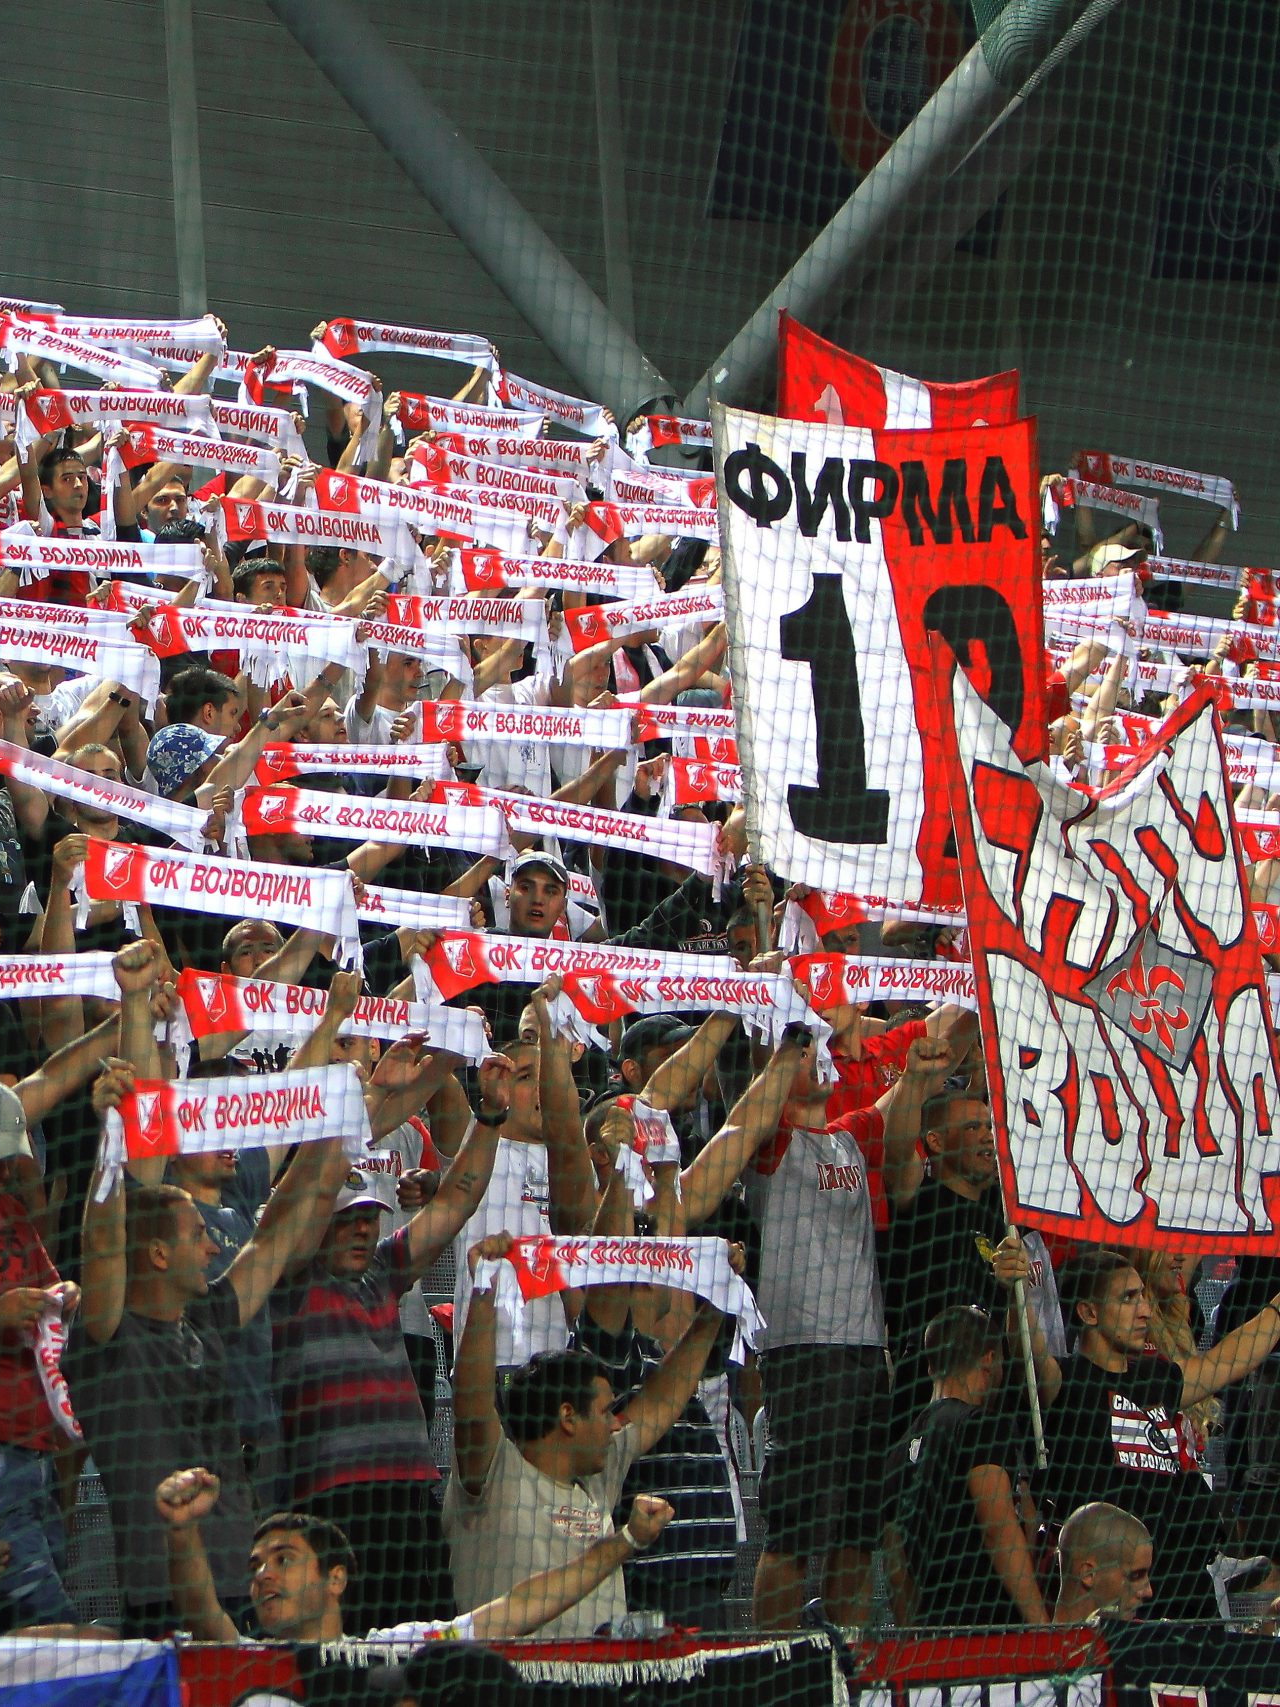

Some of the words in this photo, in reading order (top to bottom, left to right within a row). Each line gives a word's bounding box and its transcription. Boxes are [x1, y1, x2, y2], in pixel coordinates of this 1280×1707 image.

[12, 327, 37, 343] ФК
[38, 332, 121, 369] ВОЈВОДИНА
[357, 326, 376, 342] ФК
[380, 328, 452, 350] ВОЈВОДИНА
[292, 359, 372, 400] ВОЈВОДИНА
[70, 395, 93, 413] ФК
[99, 395, 187, 417] ВОЈВОДИНА
[431, 406, 449, 423] ФК
[454, 407, 521, 432] ВОЈВОДИНА
[508, 382, 524, 400] ФК
[528, 389, 585, 425] ВОЈВОДИНА
[215, 406, 279, 437] ВОДИНА
[157, 437, 176, 454] ФК
[182, 439, 259, 466] ВОЈВОДИНА
[468, 438, 493, 457] ФК
[496, 438, 582, 464] ВОЈВОДИНА
[449, 458, 471, 481] ФК
[476, 465, 558, 496] ВОЈВОДИНА
[1112, 462, 1131, 477] ФК
[1134, 464, 1206, 493] ВОЈВОДИНА
[360, 484, 382, 505] ФК
[388, 488, 473, 526] ВОЈВОДИНА
[478, 490, 561, 524] ВОЈВОДИНА
[723, 440, 1030, 547] ФИРМА
[267, 511, 290, 533] ФК
[295, 513, 383, 545] ВОЈВОДИНА
[6, 544, 33, 562] ФК
[39, 545, 143, 571] ВОЈВОДИНА
[504, 559, 526, 578] ФК
[531, 561, 617, 586] ВОЈВОДИНА
[423, 600, 443, 622] ФК
[448, 600, 524, 626] ВОЈВОДИНА
[606, 608, 630, 626] ФК
[634, 595, 717, 623] ВОЈВОДИНА
[184, 616, 208, 638] ФК
[214, 616, 308, 646] ВОЈВОДИНА
[361, 621, 426, 649] ВОДИНА
[1231, 682, 1253, 699] ФК
[467, 710, 489, 732] ФК
[495, 712, 583, 740] ВОЈВОДИНА
[299, 804, 331, 824] ФК
[335, 806, 450, 837] ВОЈВОДИНА
[528, 802, 650, 842] ВОЈВОДИНА
[149, 859, 184, 891] ФК
[190, 863, 313, 908] ВОЈВОДИНА
[488, 943, 524, 972] ФК
[618, 976, 652, 1003] ФК
[656, 975, 776, 1007] ВОЈВОДИНА
[846, 963, 871, 989] ФК
[243, 982, 277, 1014] ФК
[286, 984, 412, 1028] ВОЈДИНА
[177, 1095, 209, 1134] ФК
[214, 1084, 328, 1131] ВОЈВОДИНА
[556, 1240, 589, 1267] ФК
[589, 1239, 694, 1275] ВОЈВОДИНА
